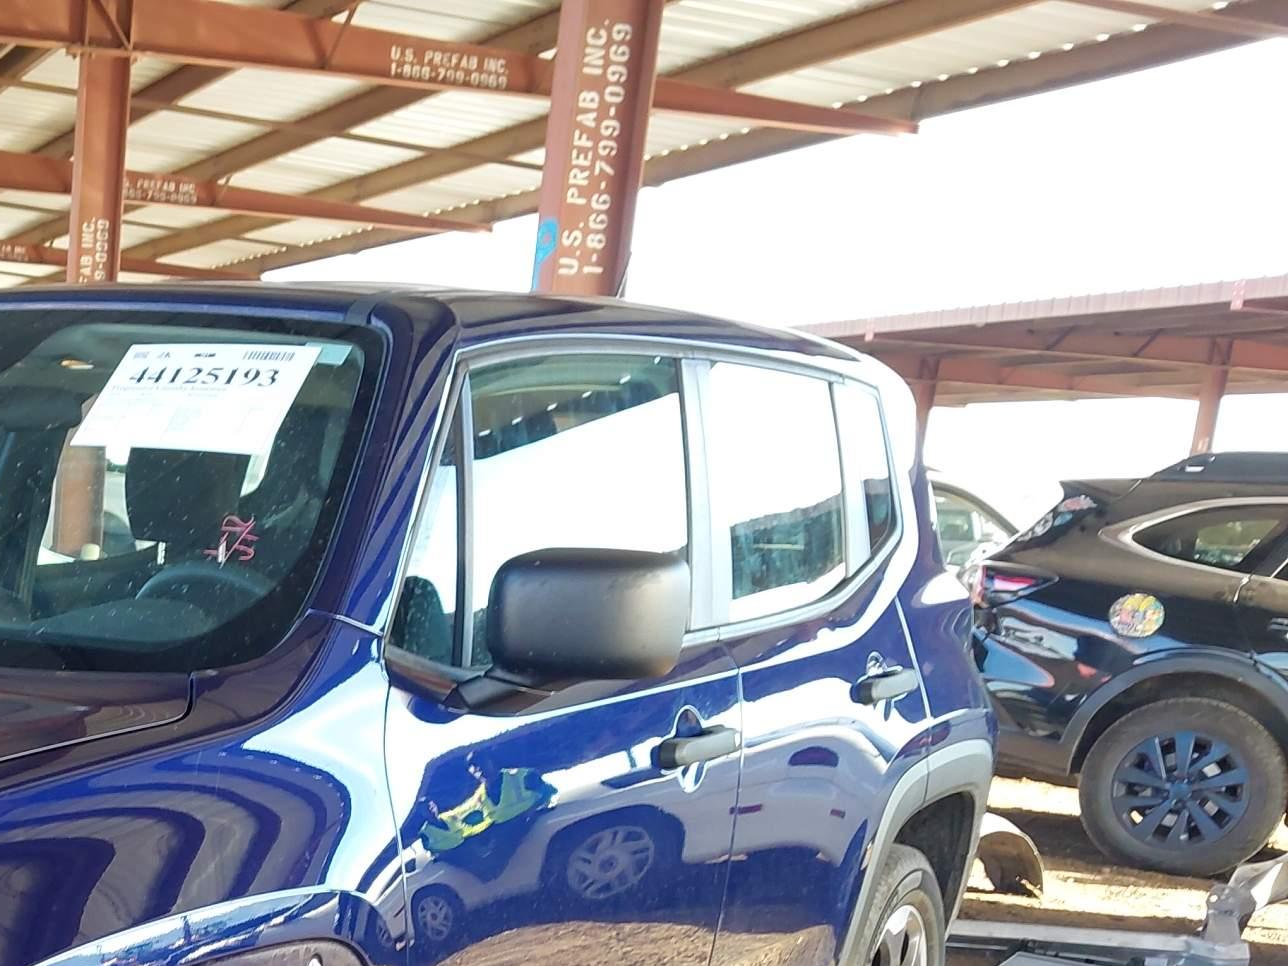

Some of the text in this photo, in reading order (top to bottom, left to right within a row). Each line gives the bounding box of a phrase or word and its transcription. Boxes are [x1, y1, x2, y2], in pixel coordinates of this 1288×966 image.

[391, 45, 509, 74] U.S. PREFAB INC.
[558, 19, 610, 275] U.S. PREFAB INC.
[582, 22, 632, 275] 1-866-799-0969
[129, 367, 280, 387] 44125193
